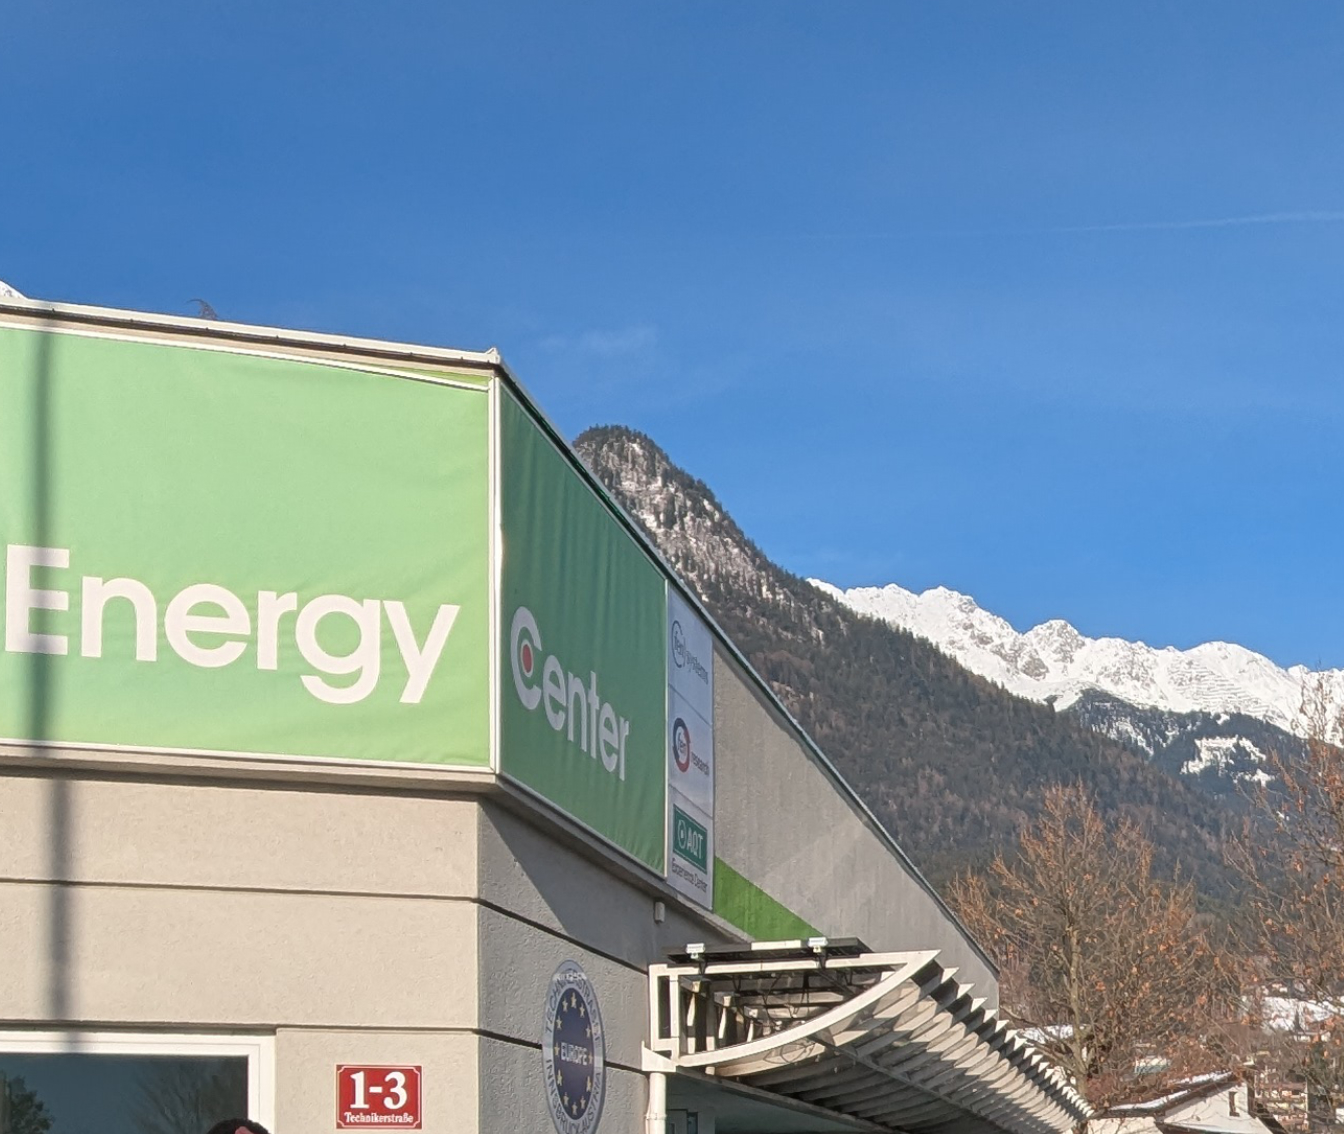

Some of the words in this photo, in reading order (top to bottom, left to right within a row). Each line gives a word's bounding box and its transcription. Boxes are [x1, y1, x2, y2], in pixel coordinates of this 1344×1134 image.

[5, 542, 460, 704] Energy
[511, 606, 629, 782] Center
[560, 1042, 588, 1066] EUROPE
[350, 1071, 407, 1109] 1-3
[344, 1112, 413, 1123] Technikerstraße
